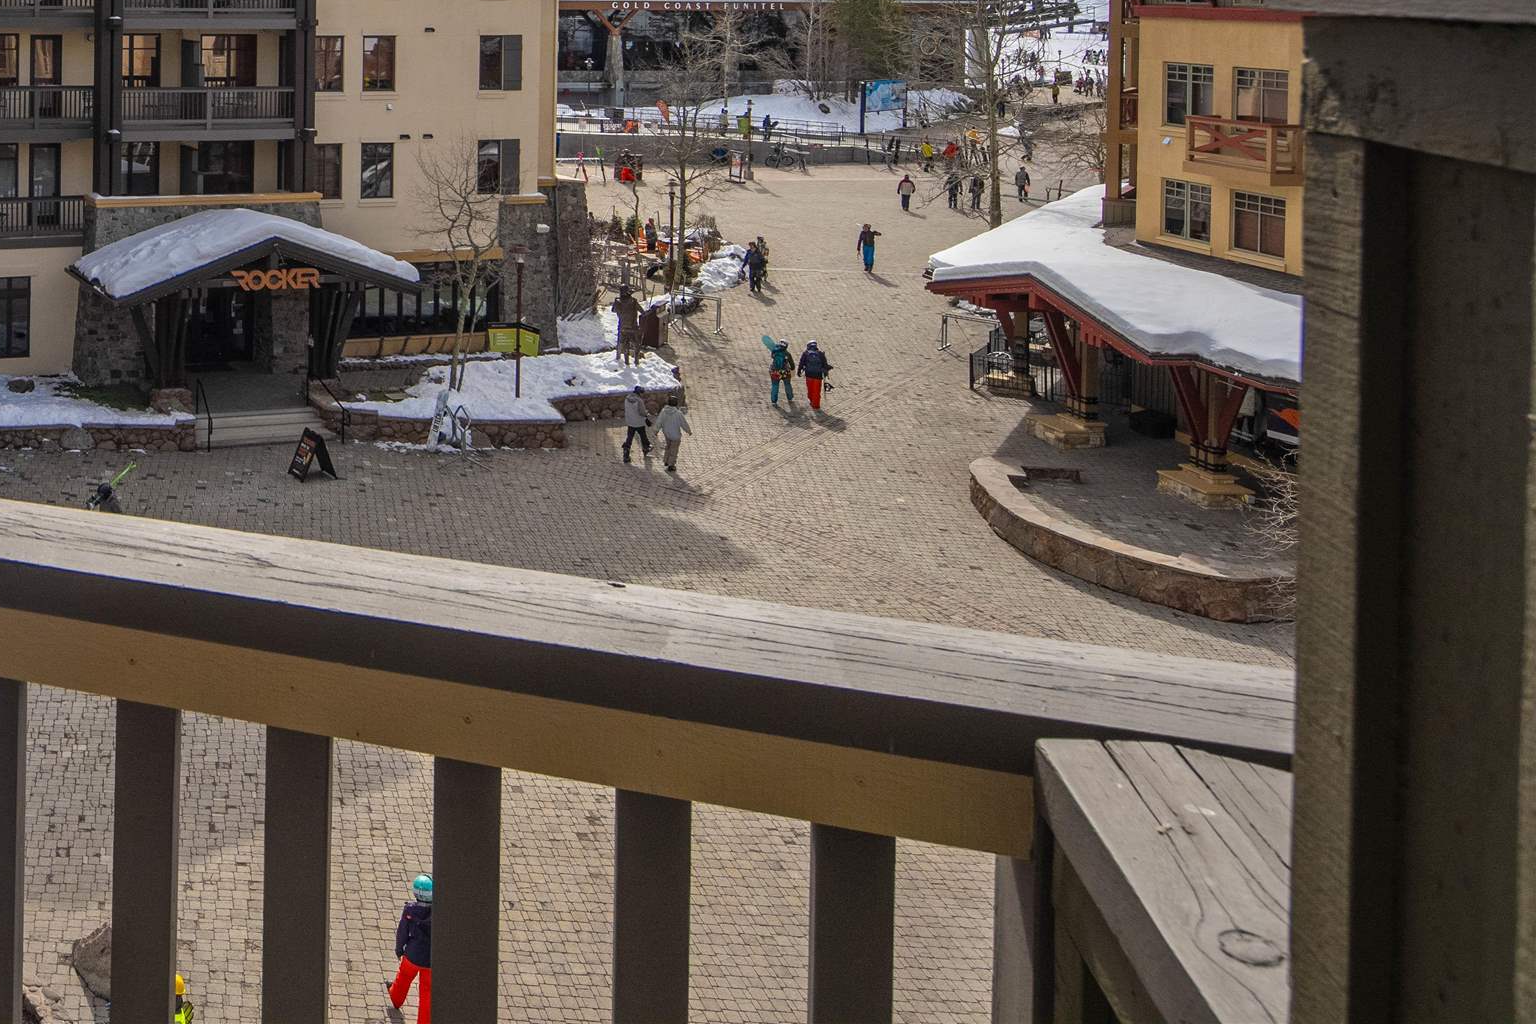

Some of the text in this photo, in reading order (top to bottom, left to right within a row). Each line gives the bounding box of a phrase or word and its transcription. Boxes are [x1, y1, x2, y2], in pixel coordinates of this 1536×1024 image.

[611, 1, 785, 10] GOLD COAST FUNITEL
[230, 267, 321, 292] ROCKER
